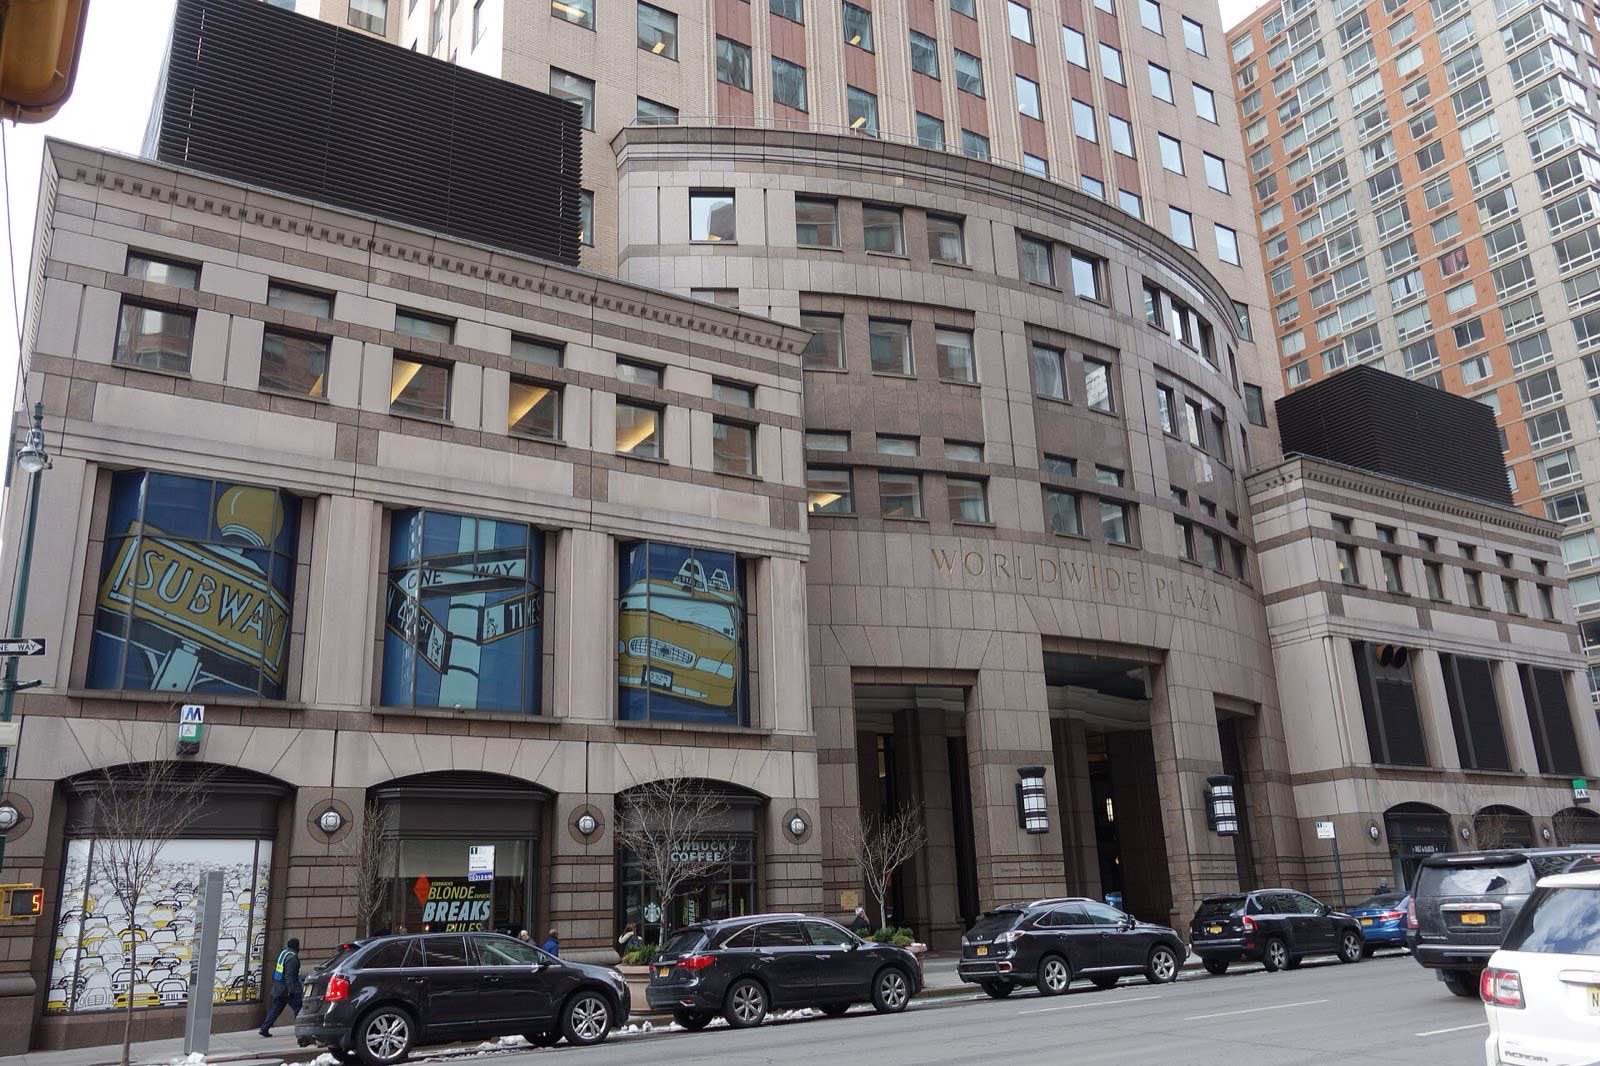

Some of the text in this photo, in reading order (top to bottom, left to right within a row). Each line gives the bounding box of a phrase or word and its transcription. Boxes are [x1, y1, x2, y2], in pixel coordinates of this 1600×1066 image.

[407, 562, 516, 589] ONE WAY
[931, 548, 1221, 616] WORLDWIDE PLAZA
[128, 551, 283, 646] SUBWAY
[18, 643, 36, 651] WAY
[671, 852, 721, 862] COFFEE
[32, 894, 40, 912] 5
[428, 886, 476, 900] BLONDE
[422, 900, 491, 922] BREAKS
